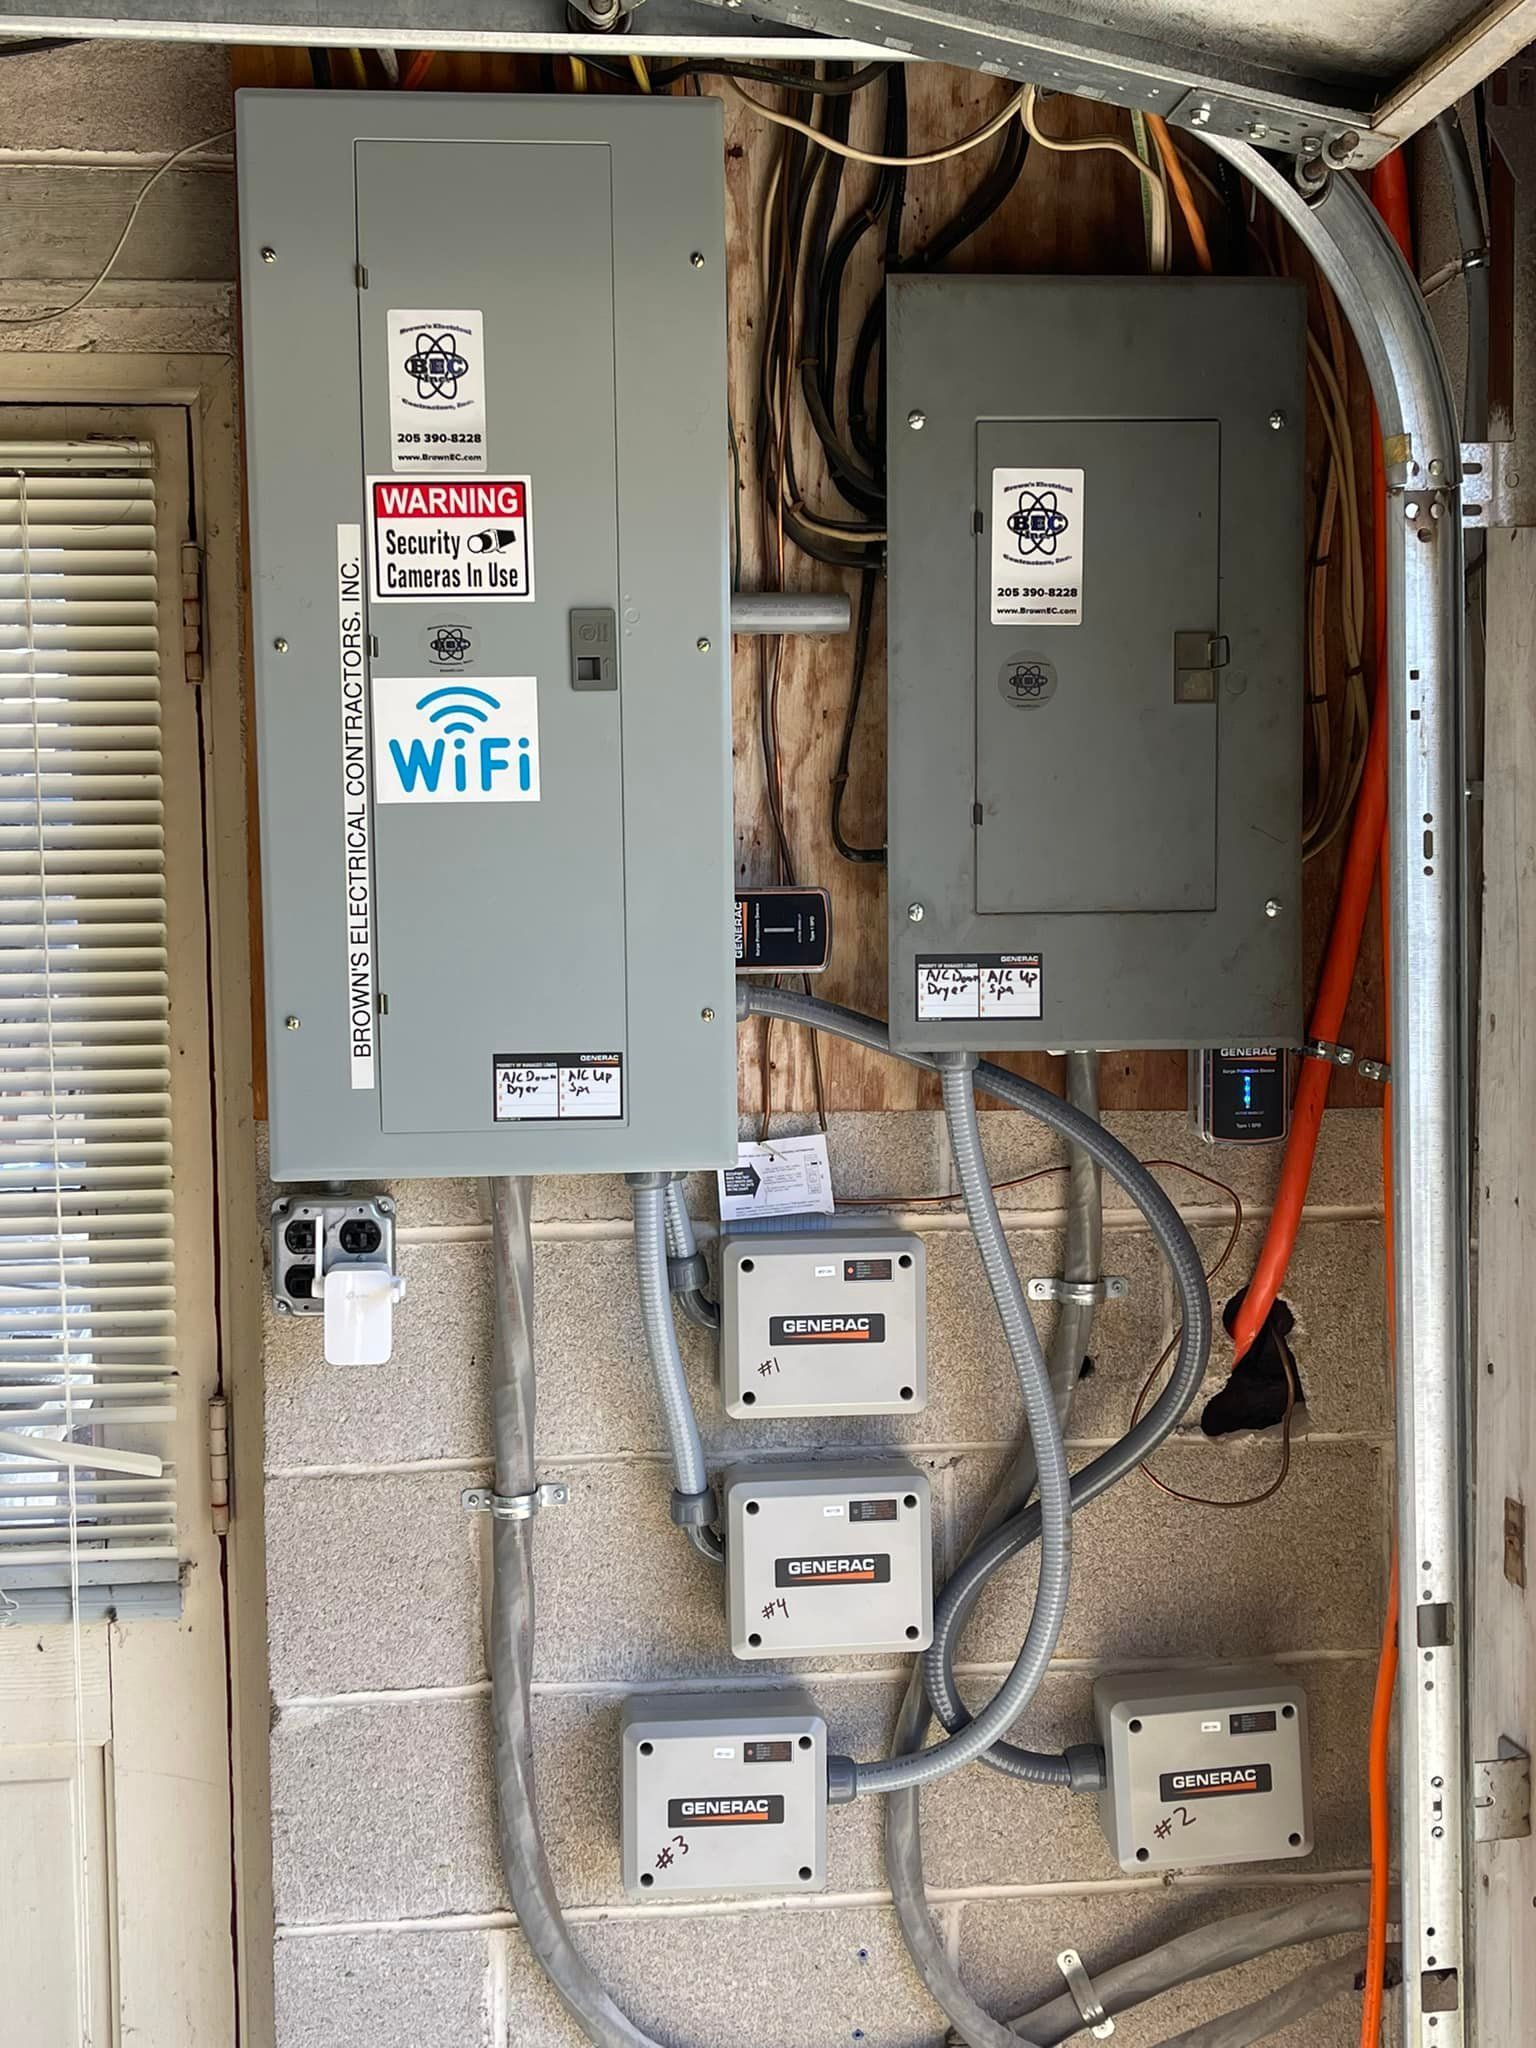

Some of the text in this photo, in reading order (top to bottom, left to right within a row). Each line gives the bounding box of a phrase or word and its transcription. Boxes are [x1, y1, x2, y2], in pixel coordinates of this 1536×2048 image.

[410, 358, 464, 375] BEC
[397, 433, 482, 443] 205 390-8228
[398, 454, 482, 462] www.BrownEC.com
[381, 487, 518, 515] WARNING
[1013, 515, 1063, 531] BEC
[386, 529, 460, 560] Security
[387, 562, 518, 588] Cameras In Use
[997, 588, 1078, 597] 205 390-8228
[389, 737, 531, 793] WiFi
[340, 557, 371, 1058] BROWN'S ELECTRICAL CONTRACTORS, INC.
[735, 902, 743, 959] GENERAC
[987, 970, 1038, 988] A/C Up
[928, 983, 968, 1001] Dryer
[1220, 1048, 1277, 1057] GENERAC
[593, 1070, 612, 1083] Up
[782, 1318, 870, 1333] GENERAC
[757, 1357, 780, 1377] #1
[788, 1558, 875, 1575] GENERAC
[761, 1598, 790, 1620] #4
[1172, 1769, 1257, 1789] GENERAC
[681, 1800, 769, 1816] GENERAC
[1153, 1807, 1197, 1840] #2
[655, 1835, 689, 1869] #3
